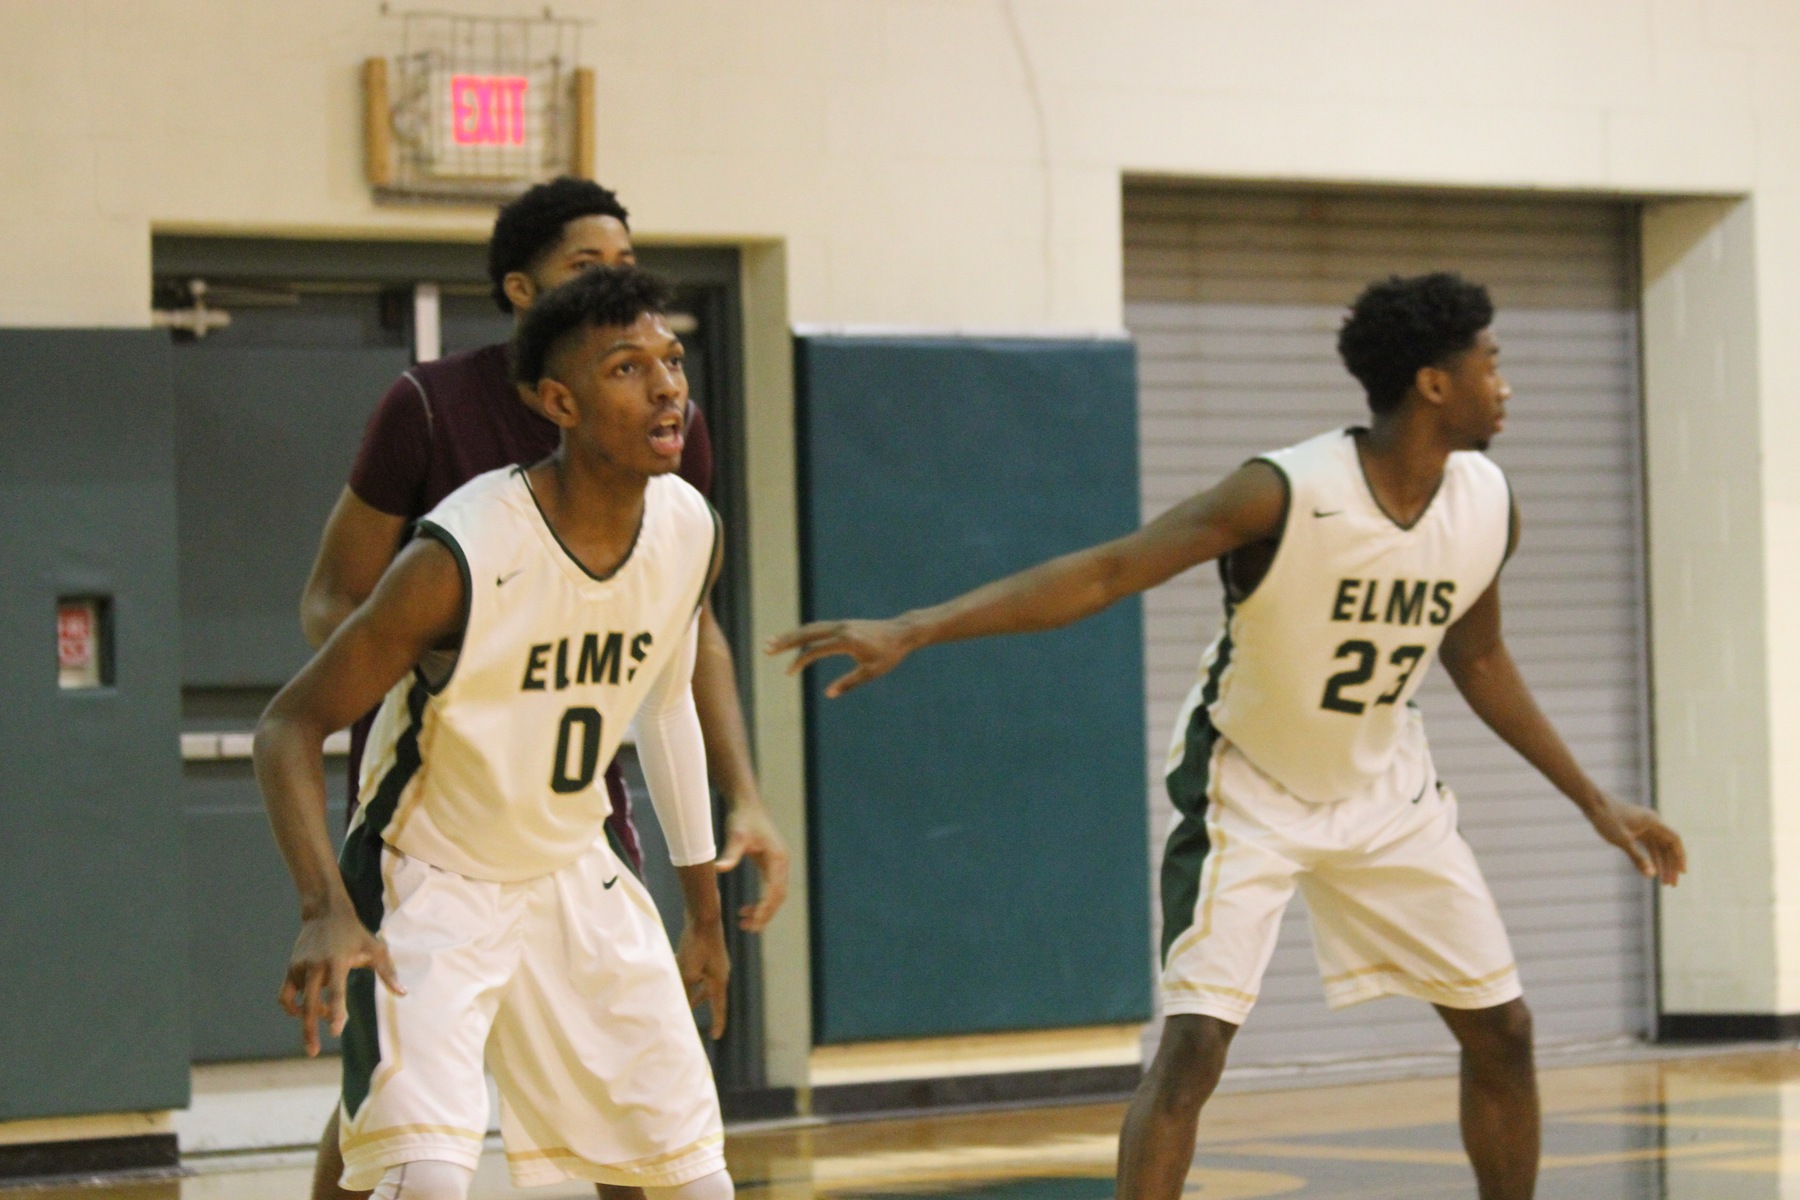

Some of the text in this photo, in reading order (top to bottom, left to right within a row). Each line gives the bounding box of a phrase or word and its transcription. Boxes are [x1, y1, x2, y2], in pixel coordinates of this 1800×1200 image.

[451, 75, 528, 145] EXIT
[1331, 579, 1456, 626] ELMS
[520, 630, 653, 691] ELMS
[551, 707, 602, 794] 0
